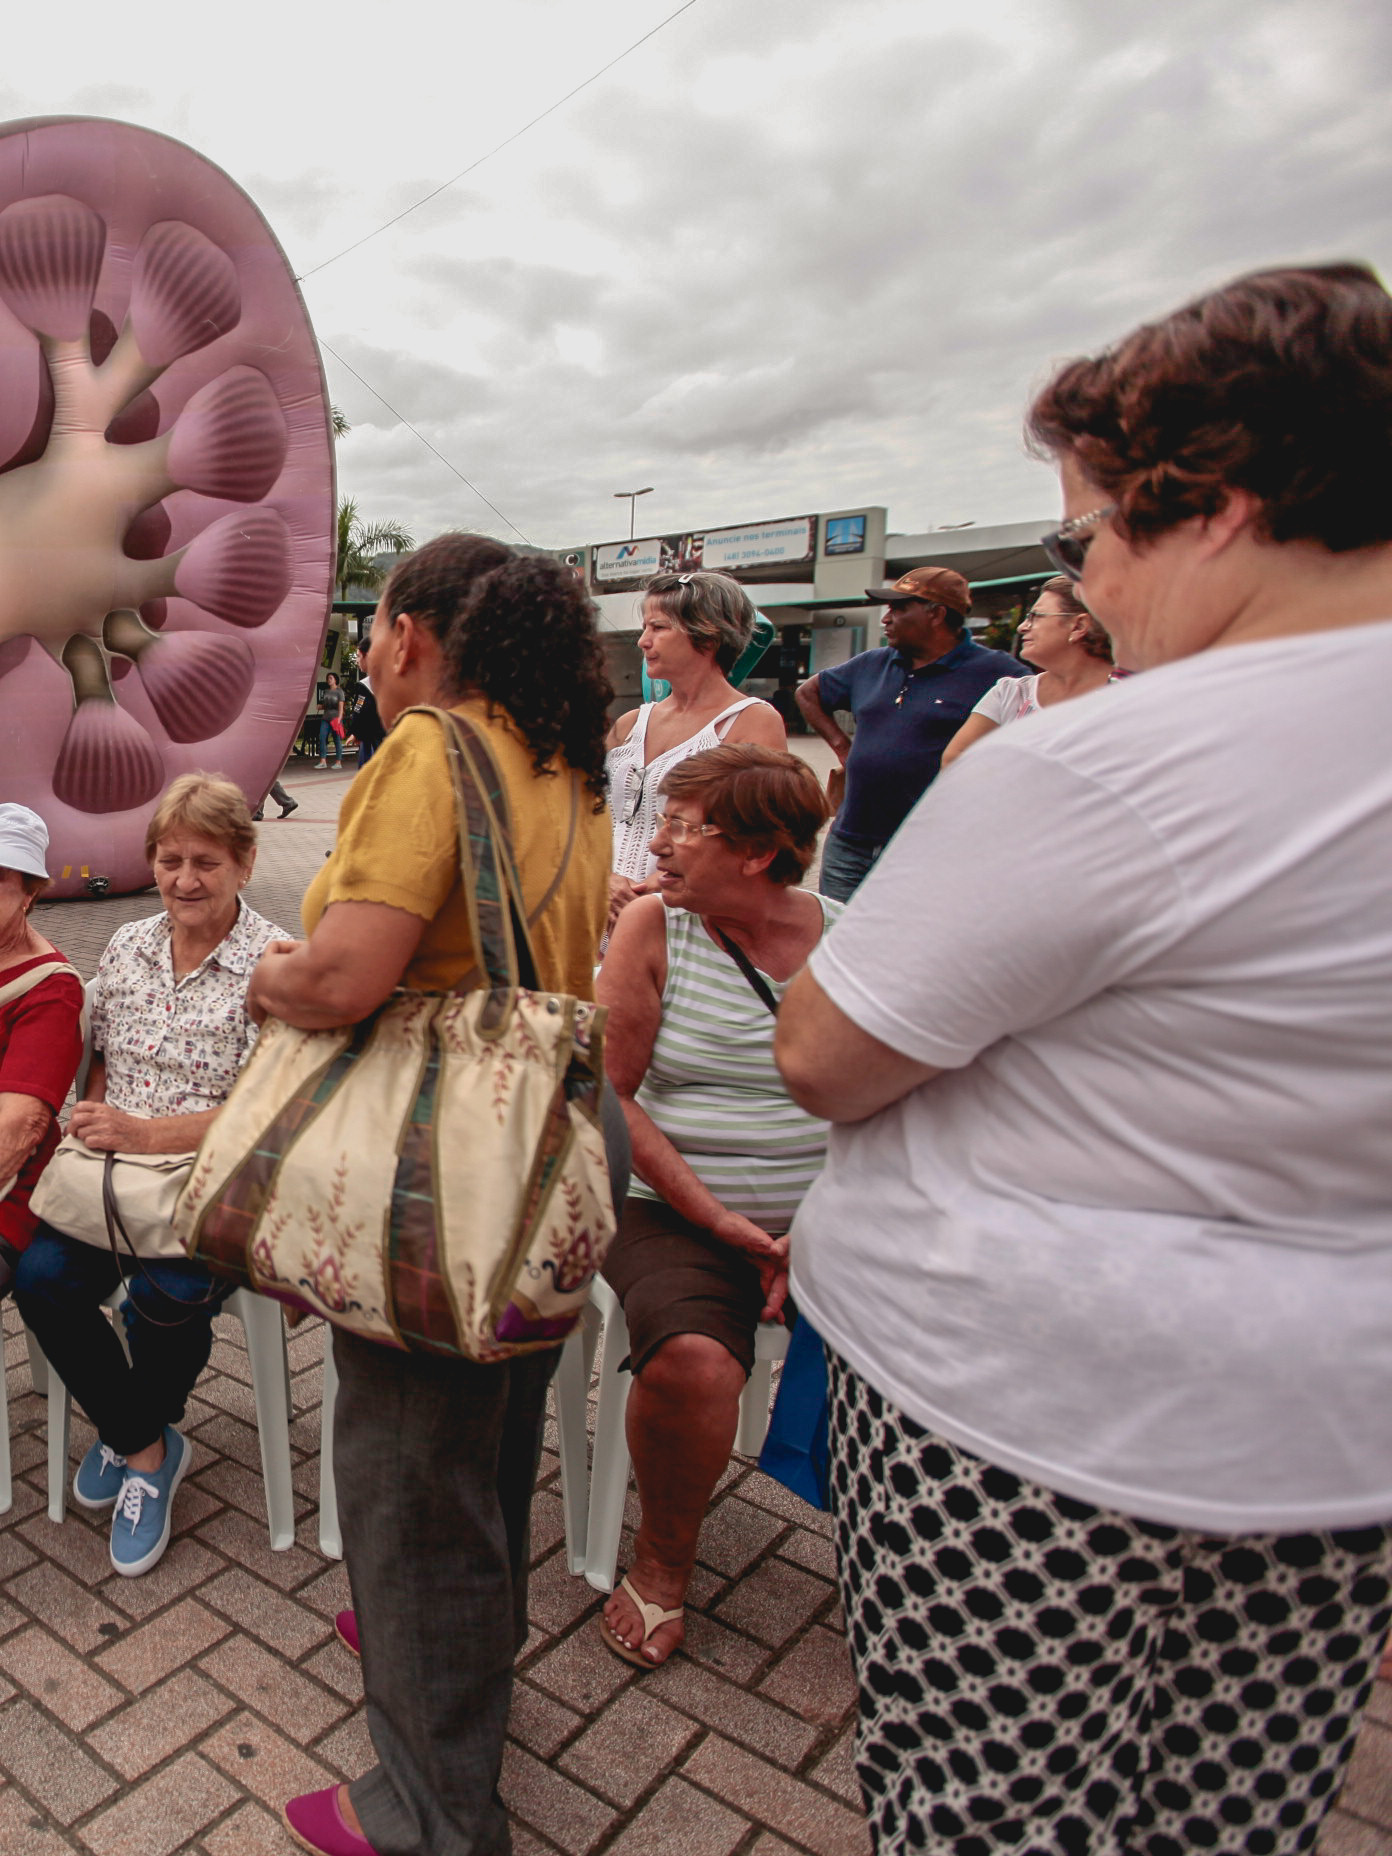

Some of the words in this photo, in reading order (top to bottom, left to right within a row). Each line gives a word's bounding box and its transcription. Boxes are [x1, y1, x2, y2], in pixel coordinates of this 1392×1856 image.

[706, 536, 741, 546] Anuncie
[743, 533, 759, 542] nos
[761, 526, 807, 539] terminais
